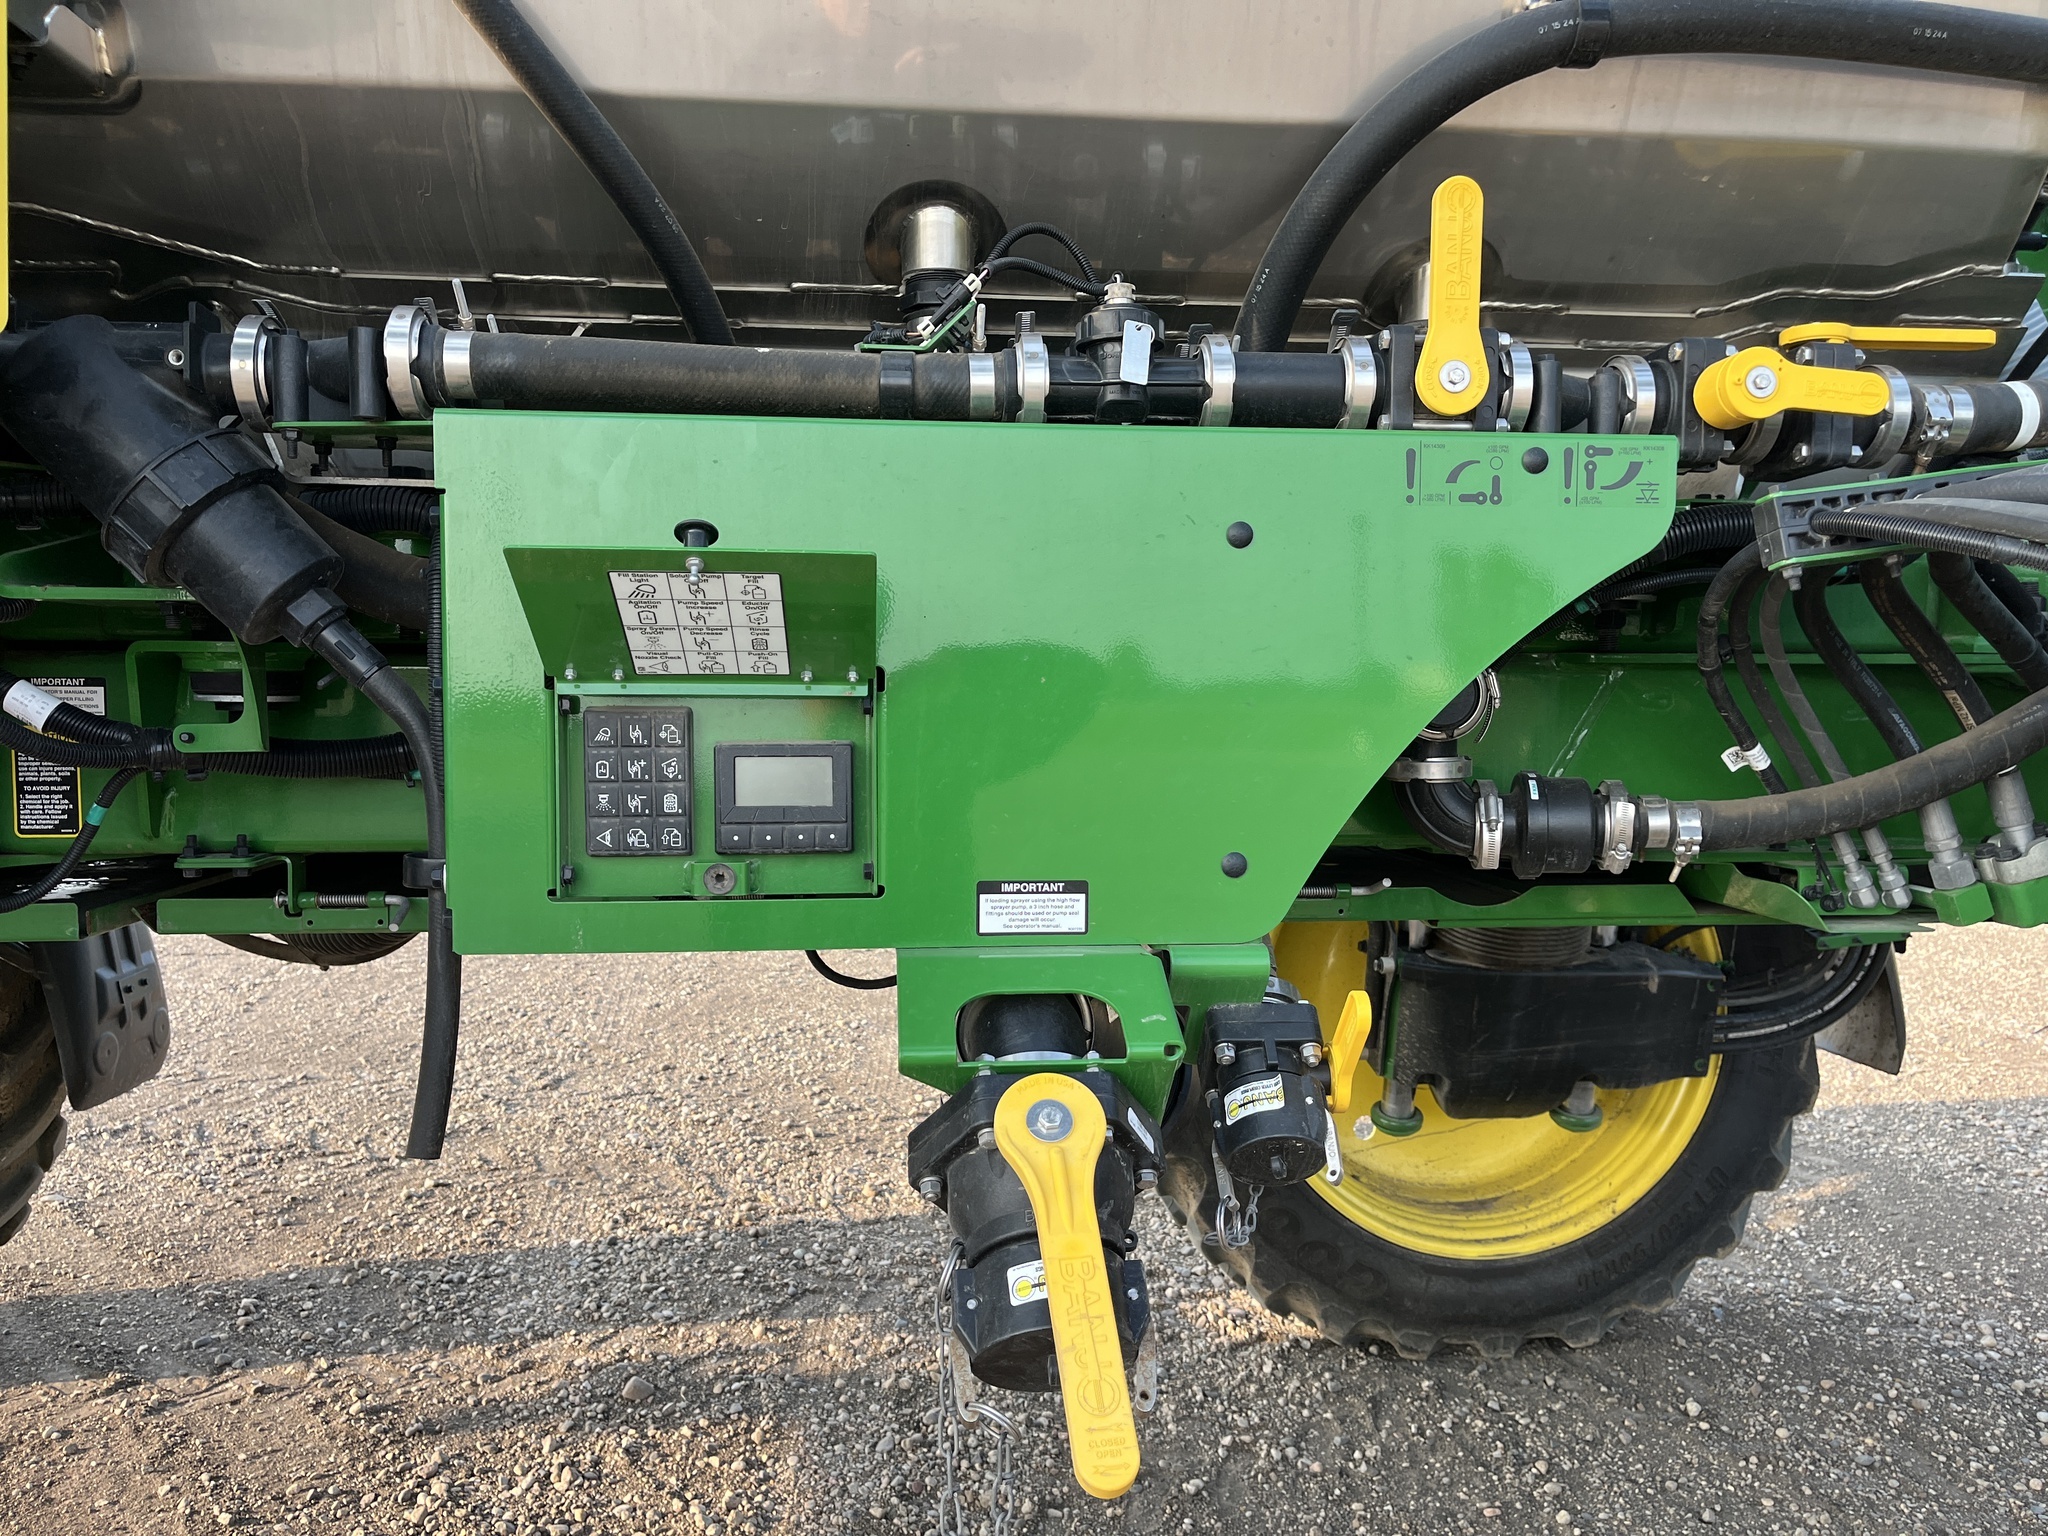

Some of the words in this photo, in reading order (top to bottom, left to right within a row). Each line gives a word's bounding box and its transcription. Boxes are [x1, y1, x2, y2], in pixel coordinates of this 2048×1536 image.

[1001, 883, 1065, 892] IMPORTANT
[1016, 1079, 1041, 1094] MADE
[1057, 1078, 1074, 1090] USA
[1228, 1086, 1284, 1120] BANJO
[1059, 1256, 1121, 1416] BANJO
[1088, 1437, 1126, 1450] CLOSED
[1096, 1448, 1122, 1459] OPEN
